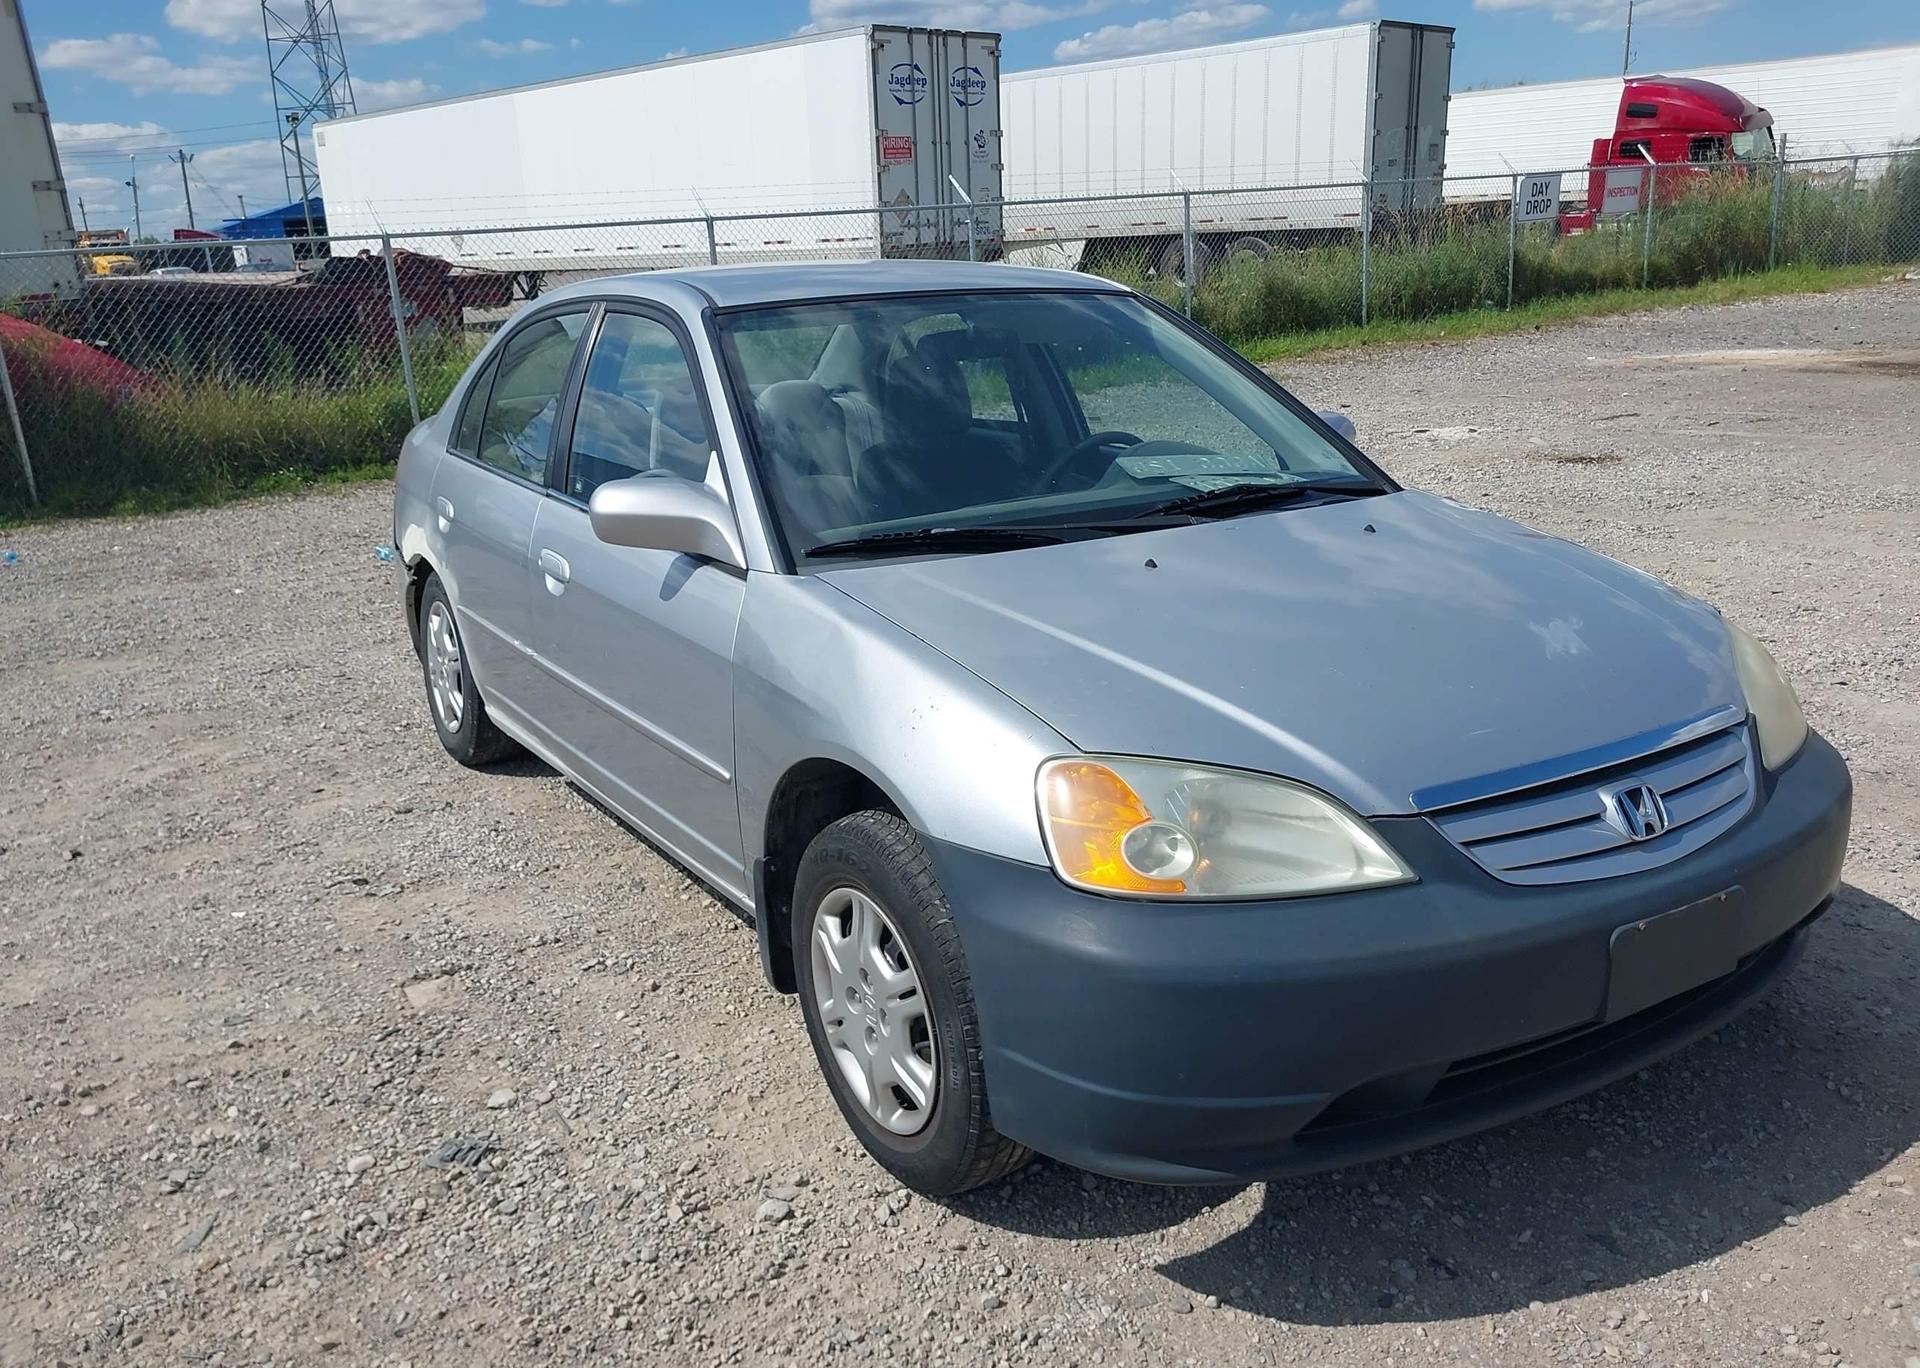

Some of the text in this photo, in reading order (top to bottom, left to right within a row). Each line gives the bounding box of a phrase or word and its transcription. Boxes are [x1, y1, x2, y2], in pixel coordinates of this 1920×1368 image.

[950, 76, 986, 91] Jagdeep
[883, 136, 912, 149] HIRING!
[1531, 181, 1551, 198] DAY
[1607, 186, 1639, 199] INSPECTION
[1525, 199, 1552, 215] DROP
